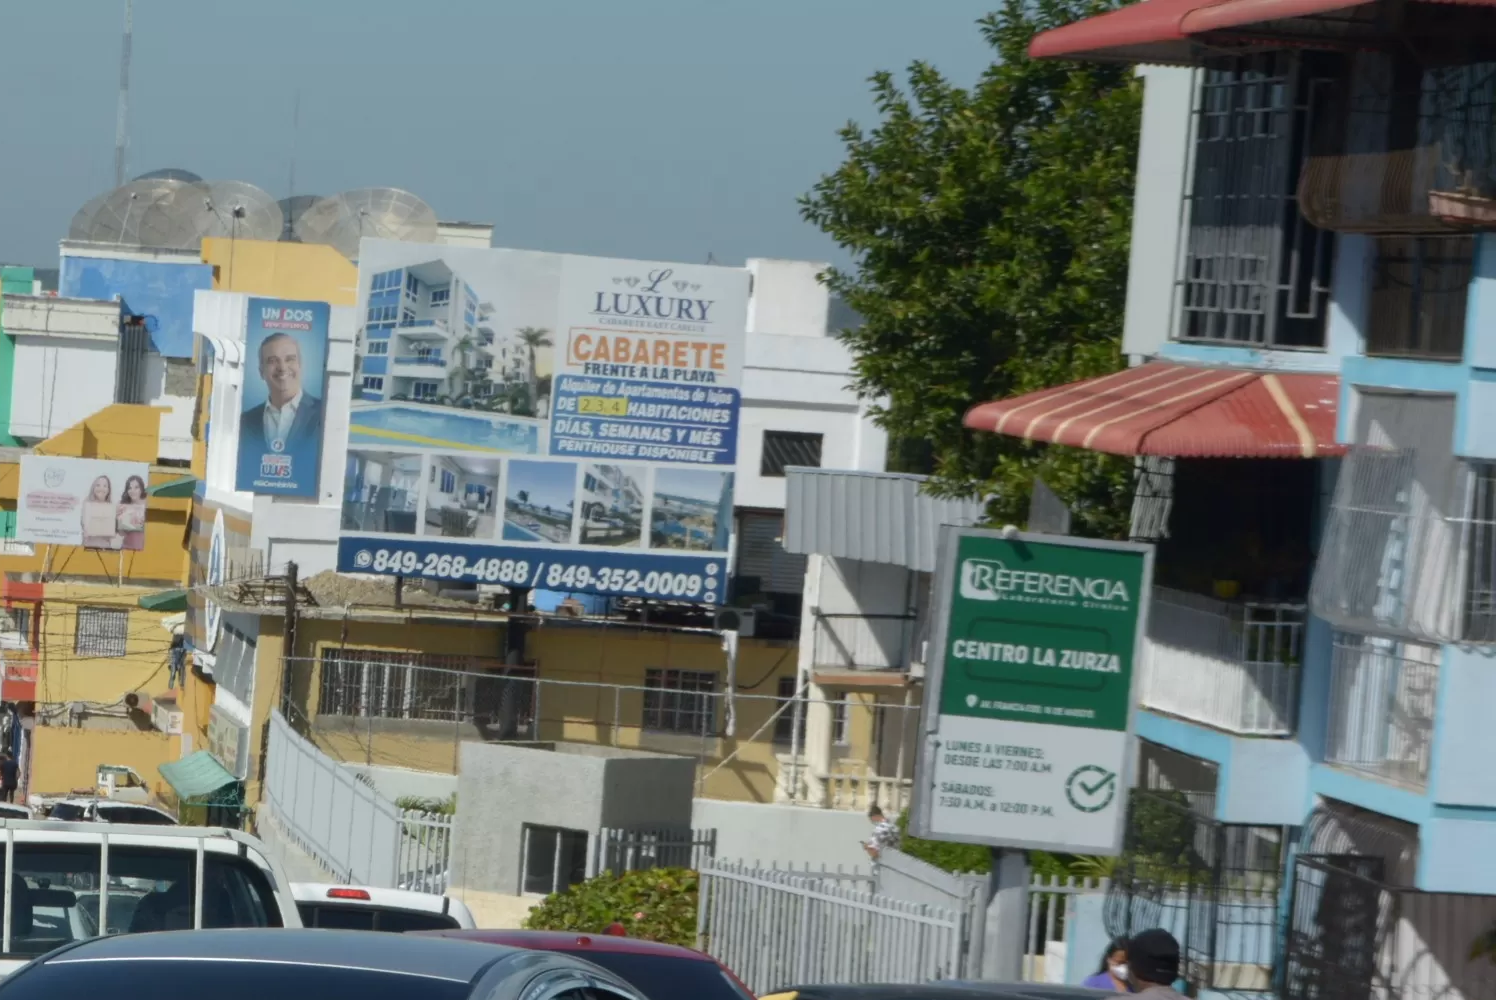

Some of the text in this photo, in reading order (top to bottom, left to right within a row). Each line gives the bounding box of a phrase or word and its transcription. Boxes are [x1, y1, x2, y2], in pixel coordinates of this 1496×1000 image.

[262, 307, 313, 321] UNIDOS
[594, 291, 715, 321] LUXURY
[573, 334, 726, 370] CABARETE
[584, 362, 717, 383] FRENTE A LA PLAYA
[560, 378, 602, 396] Alquiler
[602, 381, 617, 394] de
[616, 382, 691, 401] Apartamentos
[691, 388, 706, 402] de
[557, 396, 577, 410] DE
[626, 401, 731, 423] HABITACIONES
[555, 418, 722, 446] DÍAS, SEMANAS Y MÉS
[558, 439, 716, 462] PENTHOUSE DISPONIBLE
[373, 549, 529, 585] 849-268-4888
[546, 563, 701, 597] 849-352-0009
[973, 564, 1131, 602] REFERENCIA
[952, 639, 1122, 673] CENTRO LA ZURZA
[946, 740, 1045, 759] LUNES A VIERNES:
[944, 753, 980, 768] DESDE
[982, 757, 1003, 769] LAS
[1005, 759, 1028, 772] 7:00
[939, 796, 962, 808] 7:30
[989, 802, 998, 812] a
[999, 802, 1028, 815] 12:00
